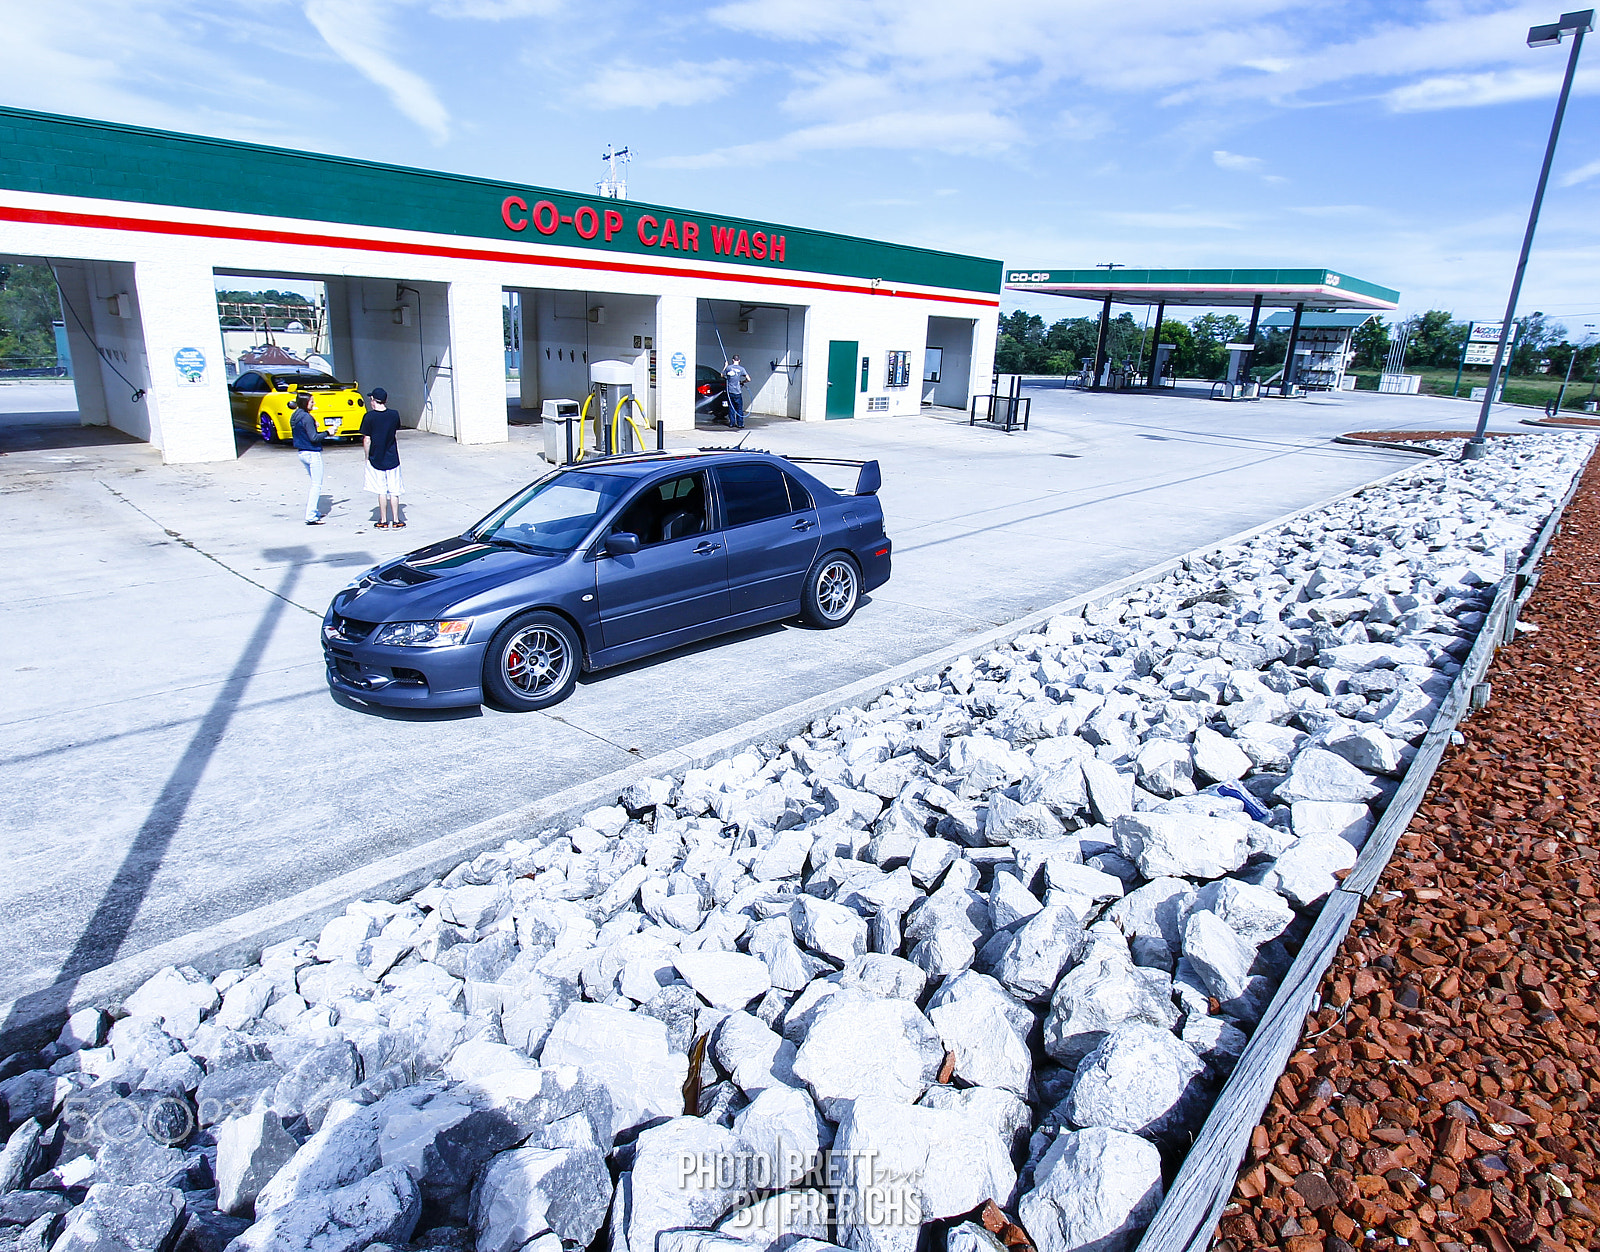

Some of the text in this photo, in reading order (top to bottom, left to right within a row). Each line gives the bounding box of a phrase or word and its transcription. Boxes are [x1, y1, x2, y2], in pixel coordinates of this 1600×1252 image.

[501, 195, 786, 262] CO-OP CAR WASH
[1010, 272, 1050, 282] CO-OP
